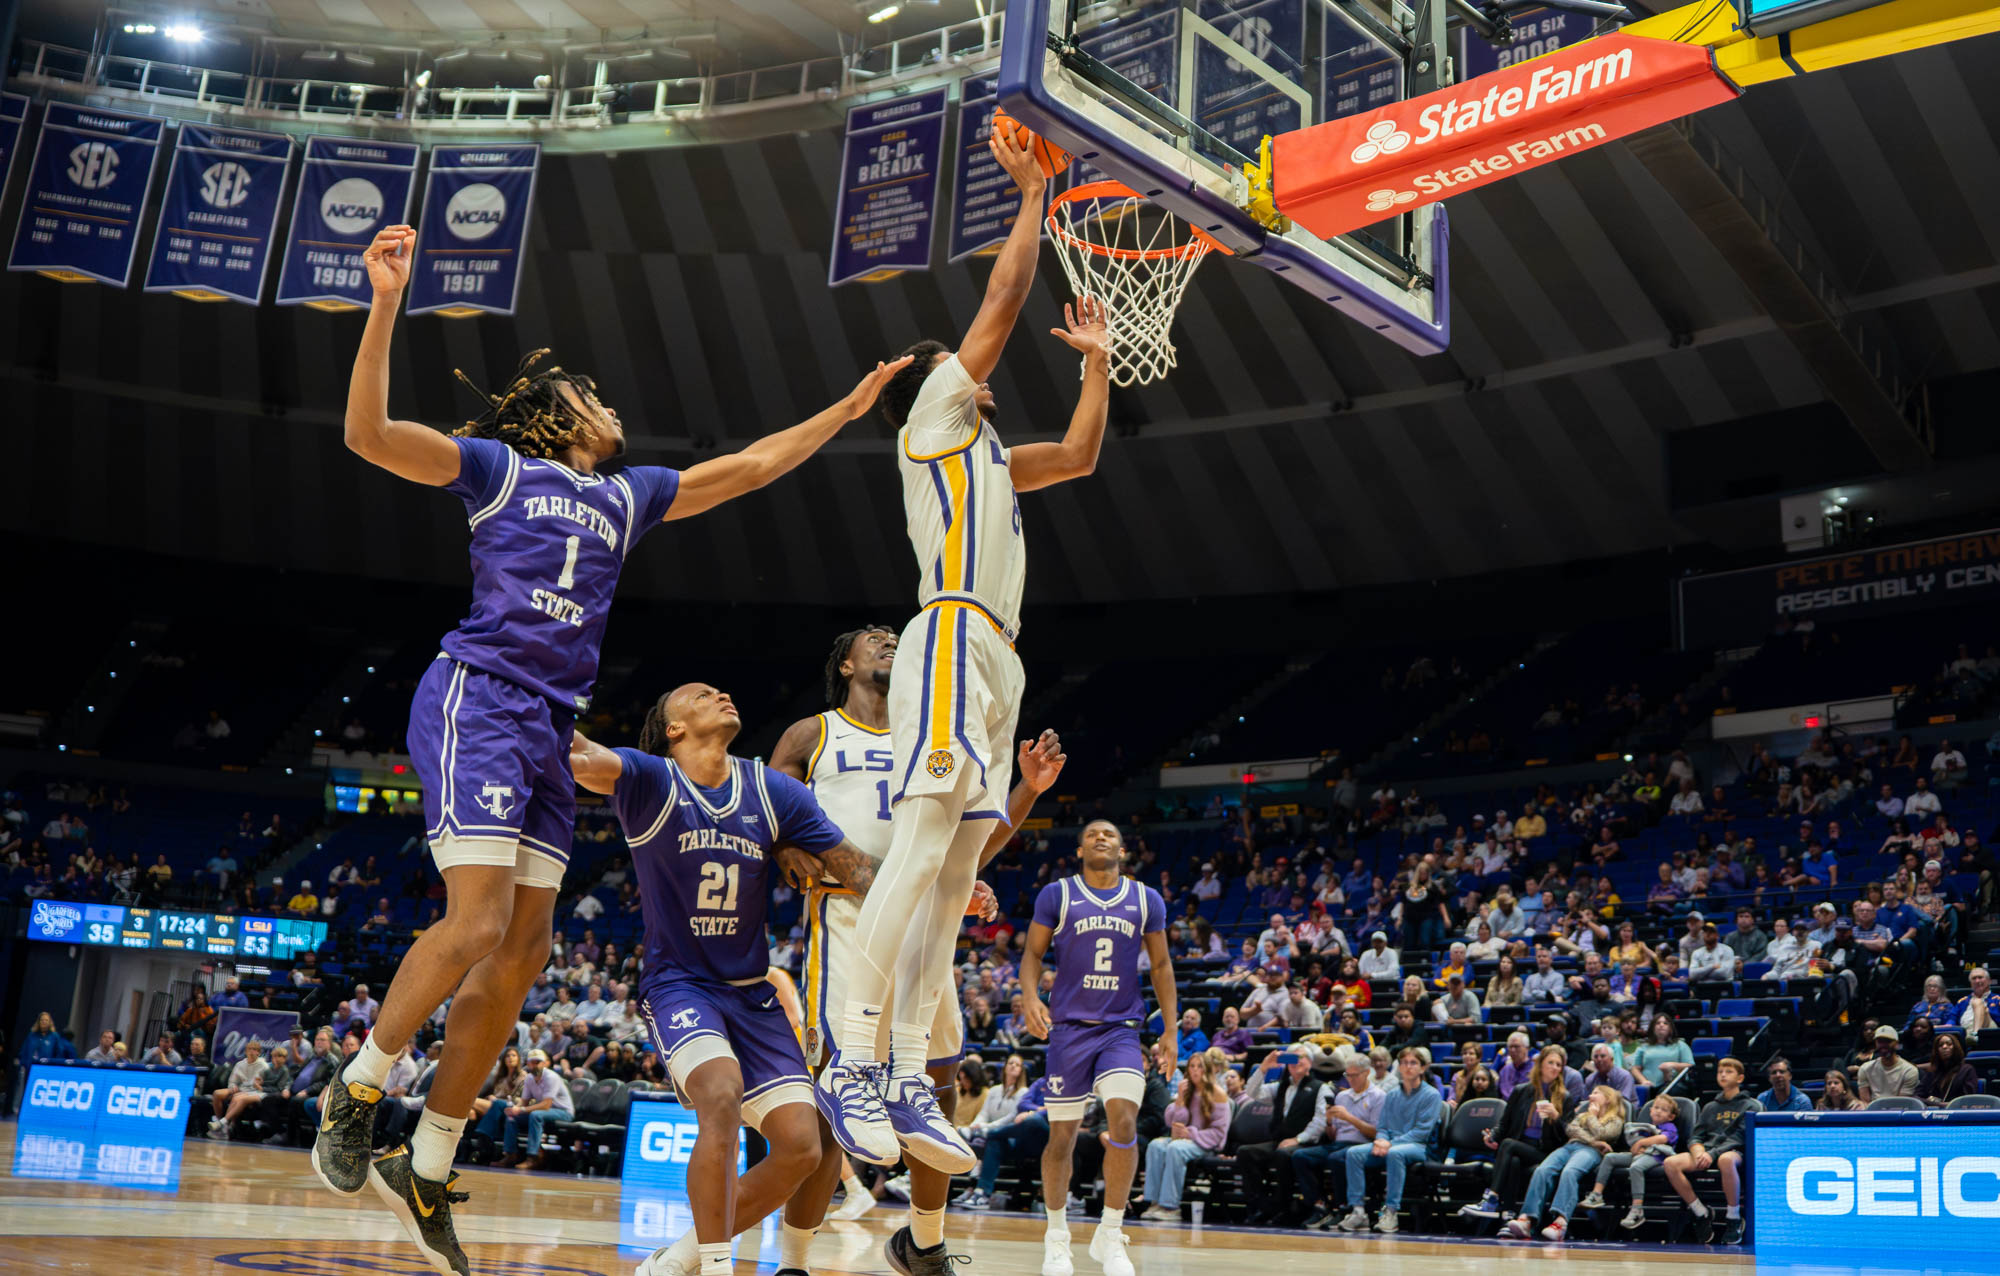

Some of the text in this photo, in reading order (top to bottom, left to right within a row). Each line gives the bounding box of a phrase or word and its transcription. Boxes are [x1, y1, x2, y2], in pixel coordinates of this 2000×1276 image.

[1541, 14, 1566, 34] SIX
[1497, 35, 1560, 70] 2008
[67, 142, 120, 190] SEC
[858, 153, 924, 183] BREAUX
[200, 162, 251, 209] SEC
[188, 211, 248, 228] CHAMPIONS
[326, 203, 378, 220] NCAA
[451, 210, 501, 225] NCAA
[306, 251, 366, 267] FINAL FOU
[433, 259, 499, 273] FINAL FOUR
[313, 266, 362, 289] 1990
[443, 274, 485, 293] 1991
[523, 495, 618, 552] TARLETON
[557, 535, 580, 591] 1
[1776, 556, 1865, 590] PETE
[1776, 572, 1936, 615] ASSEMBLY
[530, 588, 584, 628] STATE
[836, 749, 894, 773] LS
[875, 780, 893, 821] 1
[678, 829, 763, 860] TARLETON
[697, 861, 740, 911] 21
[88, 923, 115, 943] 35
[133, 916, 144, 931] 3
[159, 914, 207, 935] 17:24
[218, 923, 229, 937] 0
[244, 921, 272, 933] LSU
[689, 916, 739, 937] STATE
[1074, 915, 1136, 939] TARLETON
[186, 937, 195, 949] 2
[243, 936, 270, 955] 53
[1094, 937, 1114, 972] 2
[1083, 974, 1120, 991] STATE
[30, 1078, 181, 1119] GEICO GEICO
